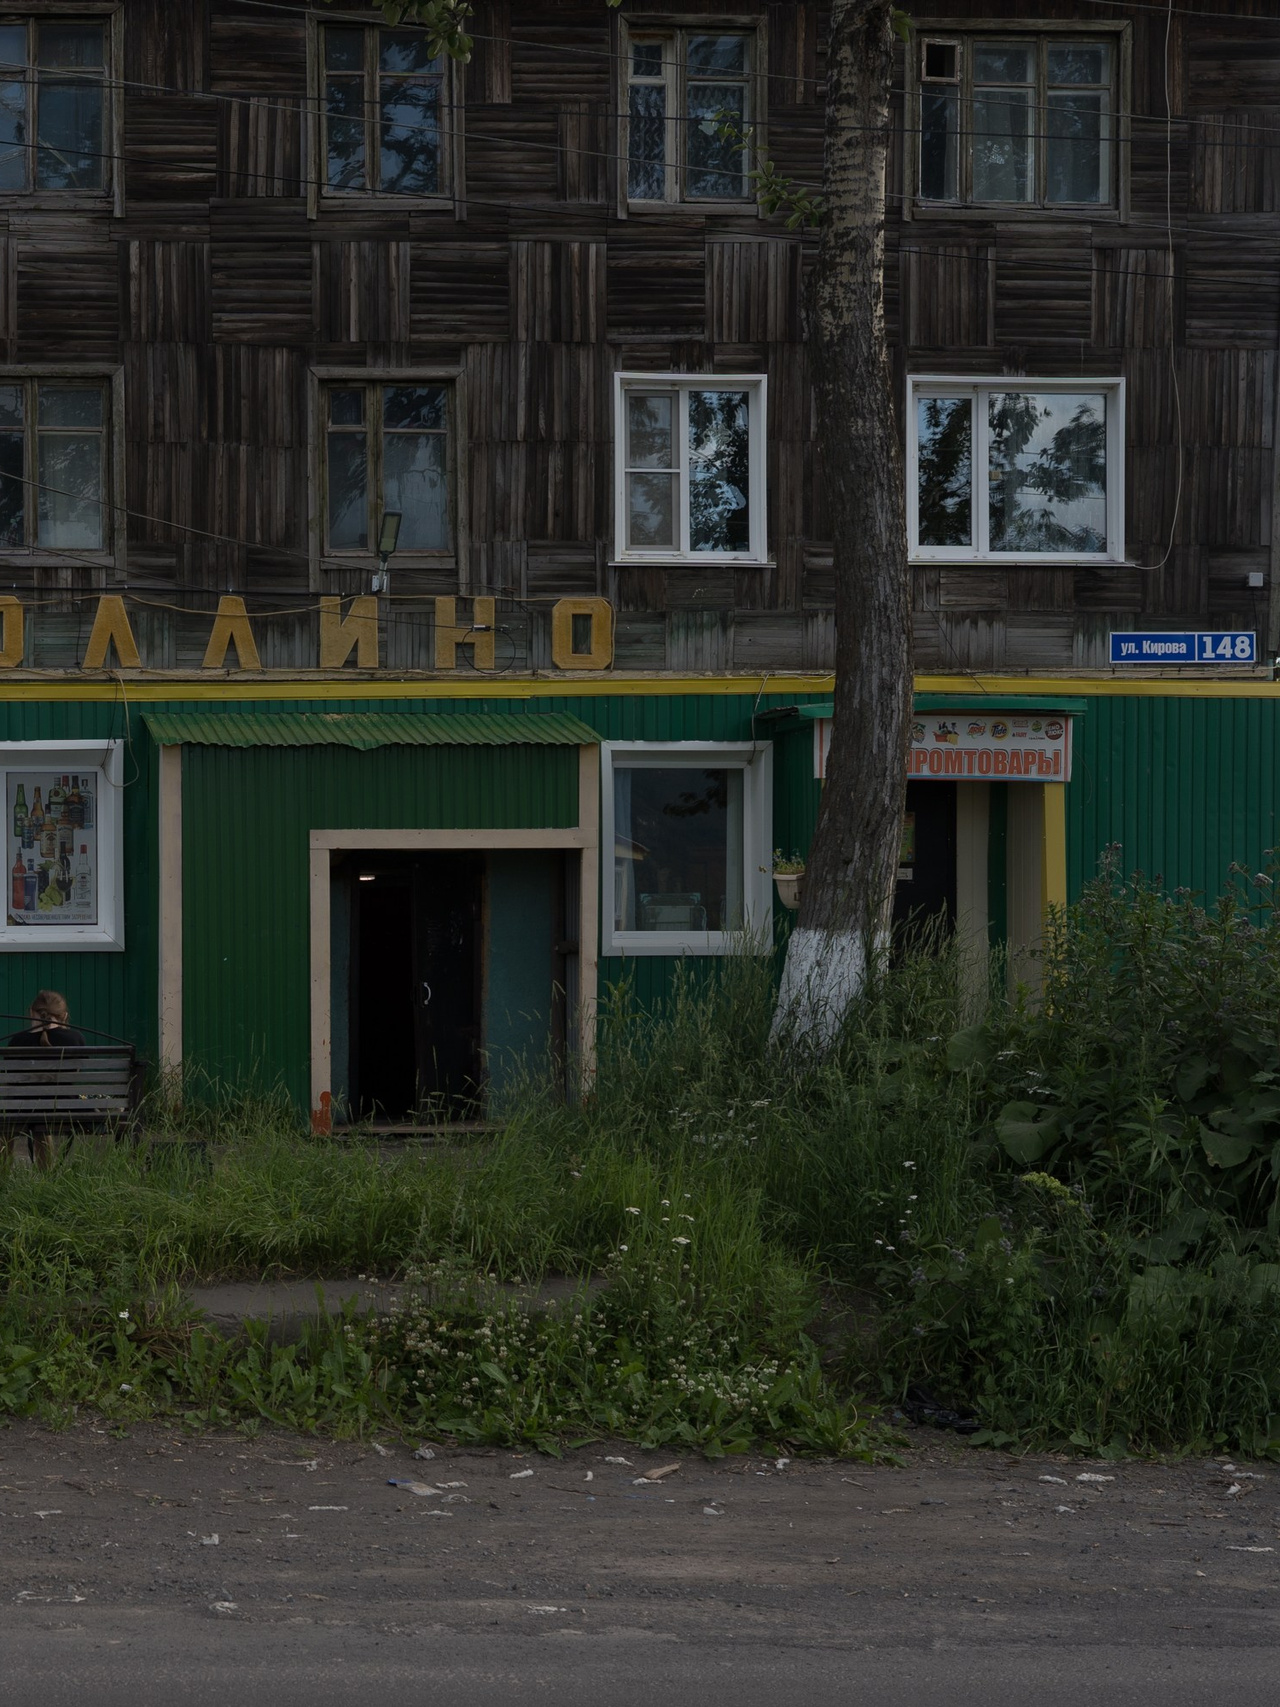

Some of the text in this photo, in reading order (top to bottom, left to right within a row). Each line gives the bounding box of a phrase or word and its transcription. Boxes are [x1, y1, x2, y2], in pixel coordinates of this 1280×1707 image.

[1121, 635, 1251, 659] ул. Кирова 148
[991, 724, 1008, 738] Tide
